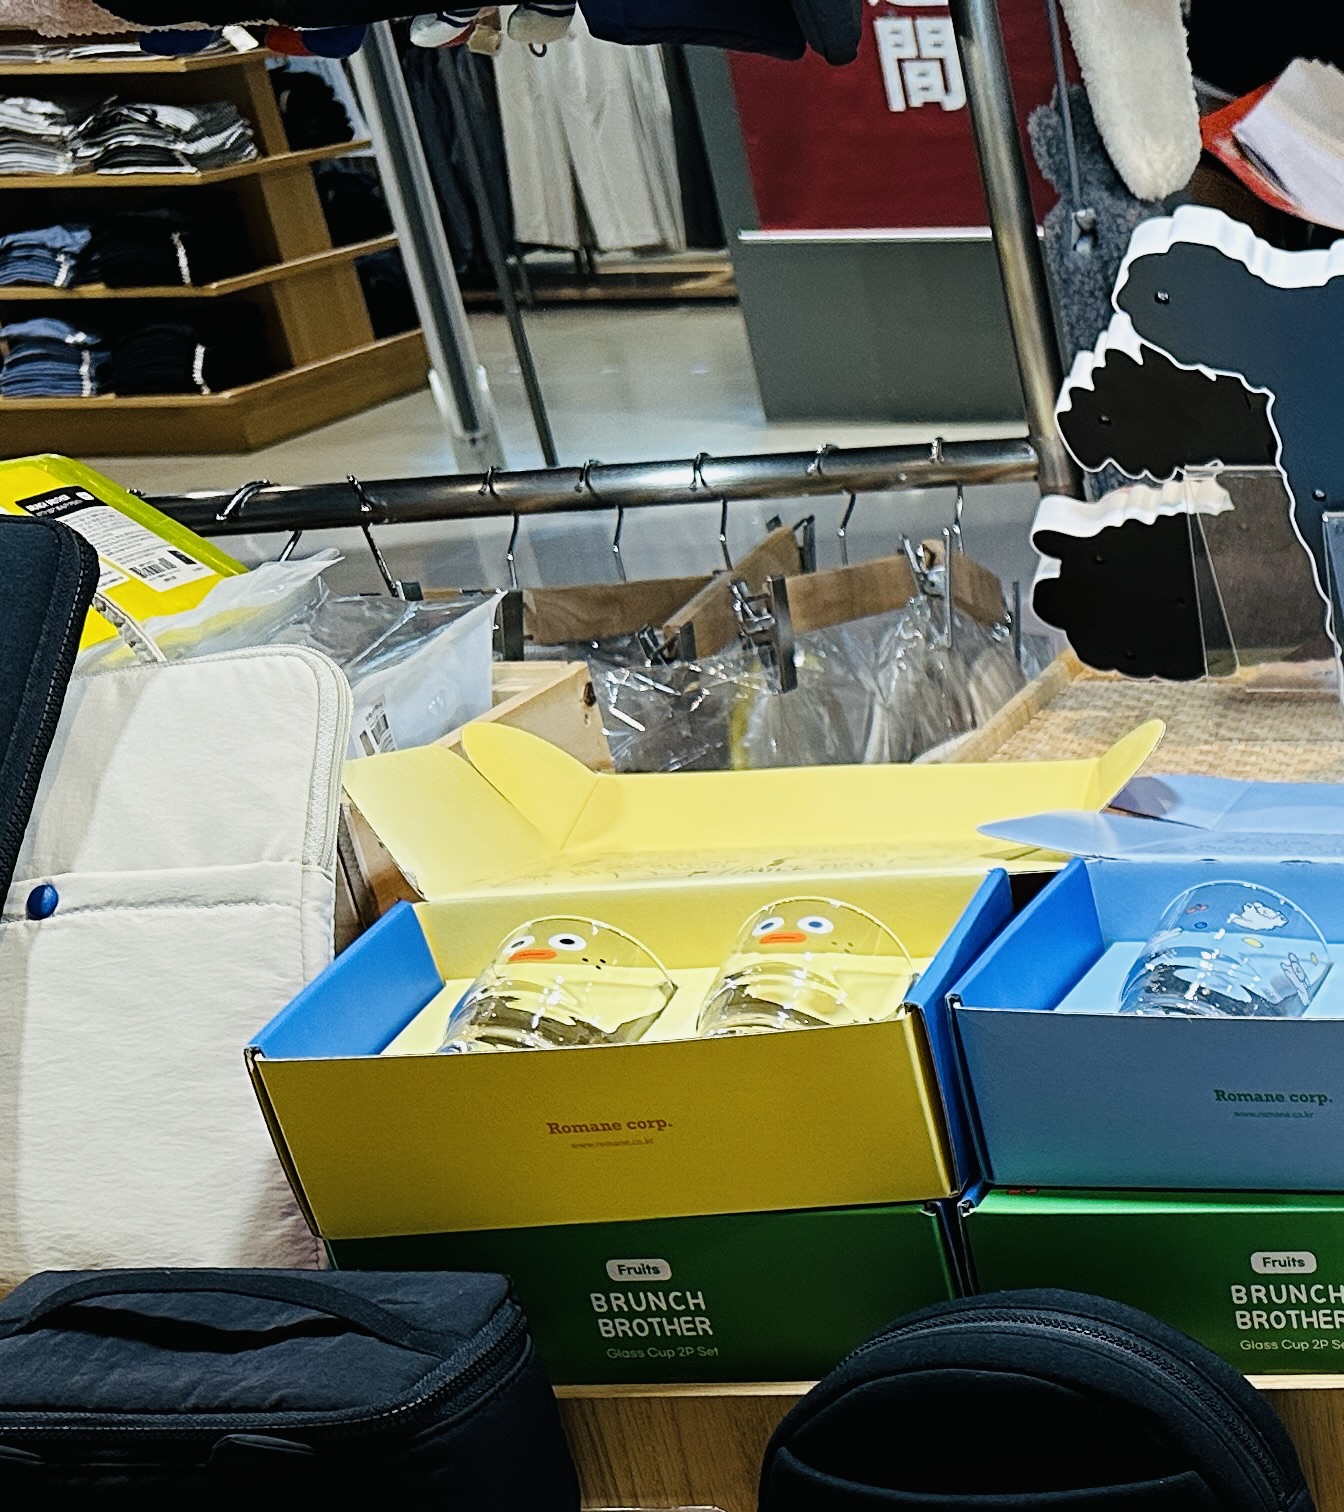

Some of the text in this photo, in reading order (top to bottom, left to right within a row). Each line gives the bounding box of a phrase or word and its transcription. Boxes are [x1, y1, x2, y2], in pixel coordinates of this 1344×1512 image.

[868, 0, 966, 112] 間
[1214, 1089, 1333, 1106] Romane corp.
[546, 1119, 673, 1135] Romane corp.
[617, 1263, 661, 1276] Fruits
[1262, 1256, 1306, 1268] Fruits
[589, 1291, 707, 1313] BRUNCH
[597, 1316, 714, 1338] BROTHER
[606, 1346, 720, 1359] Glass Cup 2P Set
[1240, 1339, 1279, 1351] Glass
[1281, 1339, 1310, 1352] Cup
[1312, 1339, 1329, 1350] 2P
